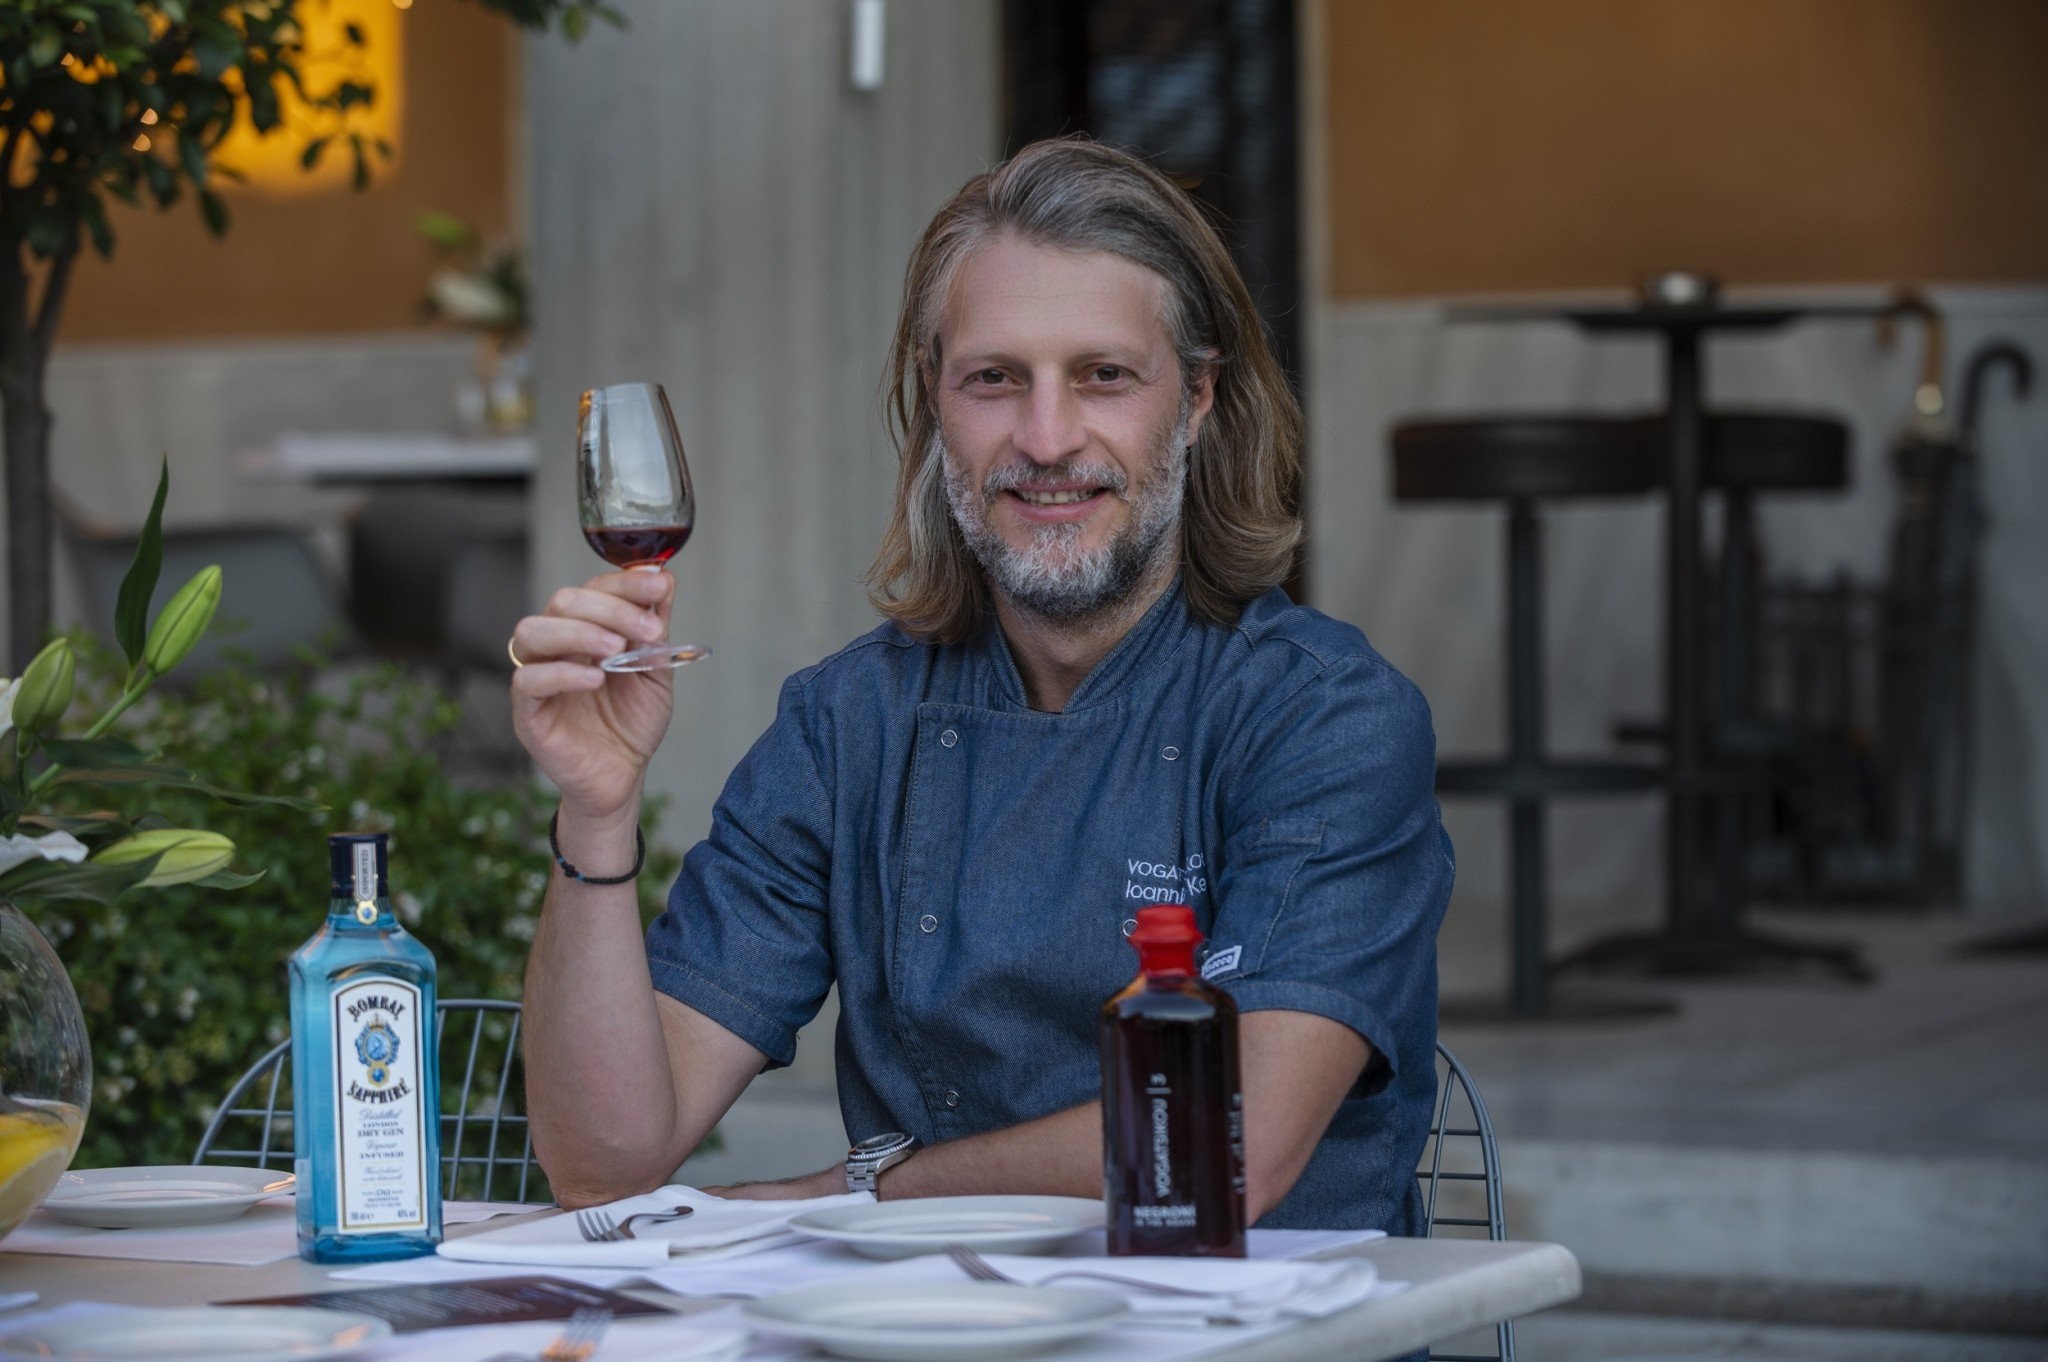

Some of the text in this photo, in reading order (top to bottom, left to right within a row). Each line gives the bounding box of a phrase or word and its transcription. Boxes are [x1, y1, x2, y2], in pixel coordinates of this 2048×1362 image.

[347, 995, 406, 1022] BOMBAY
[346, 1077, 411, 1104] SAPPHIRE
[357, 1127, 405, 1138] DRY GIN
[1152, 1098, 1171, 1198] VOGATSIKOU
